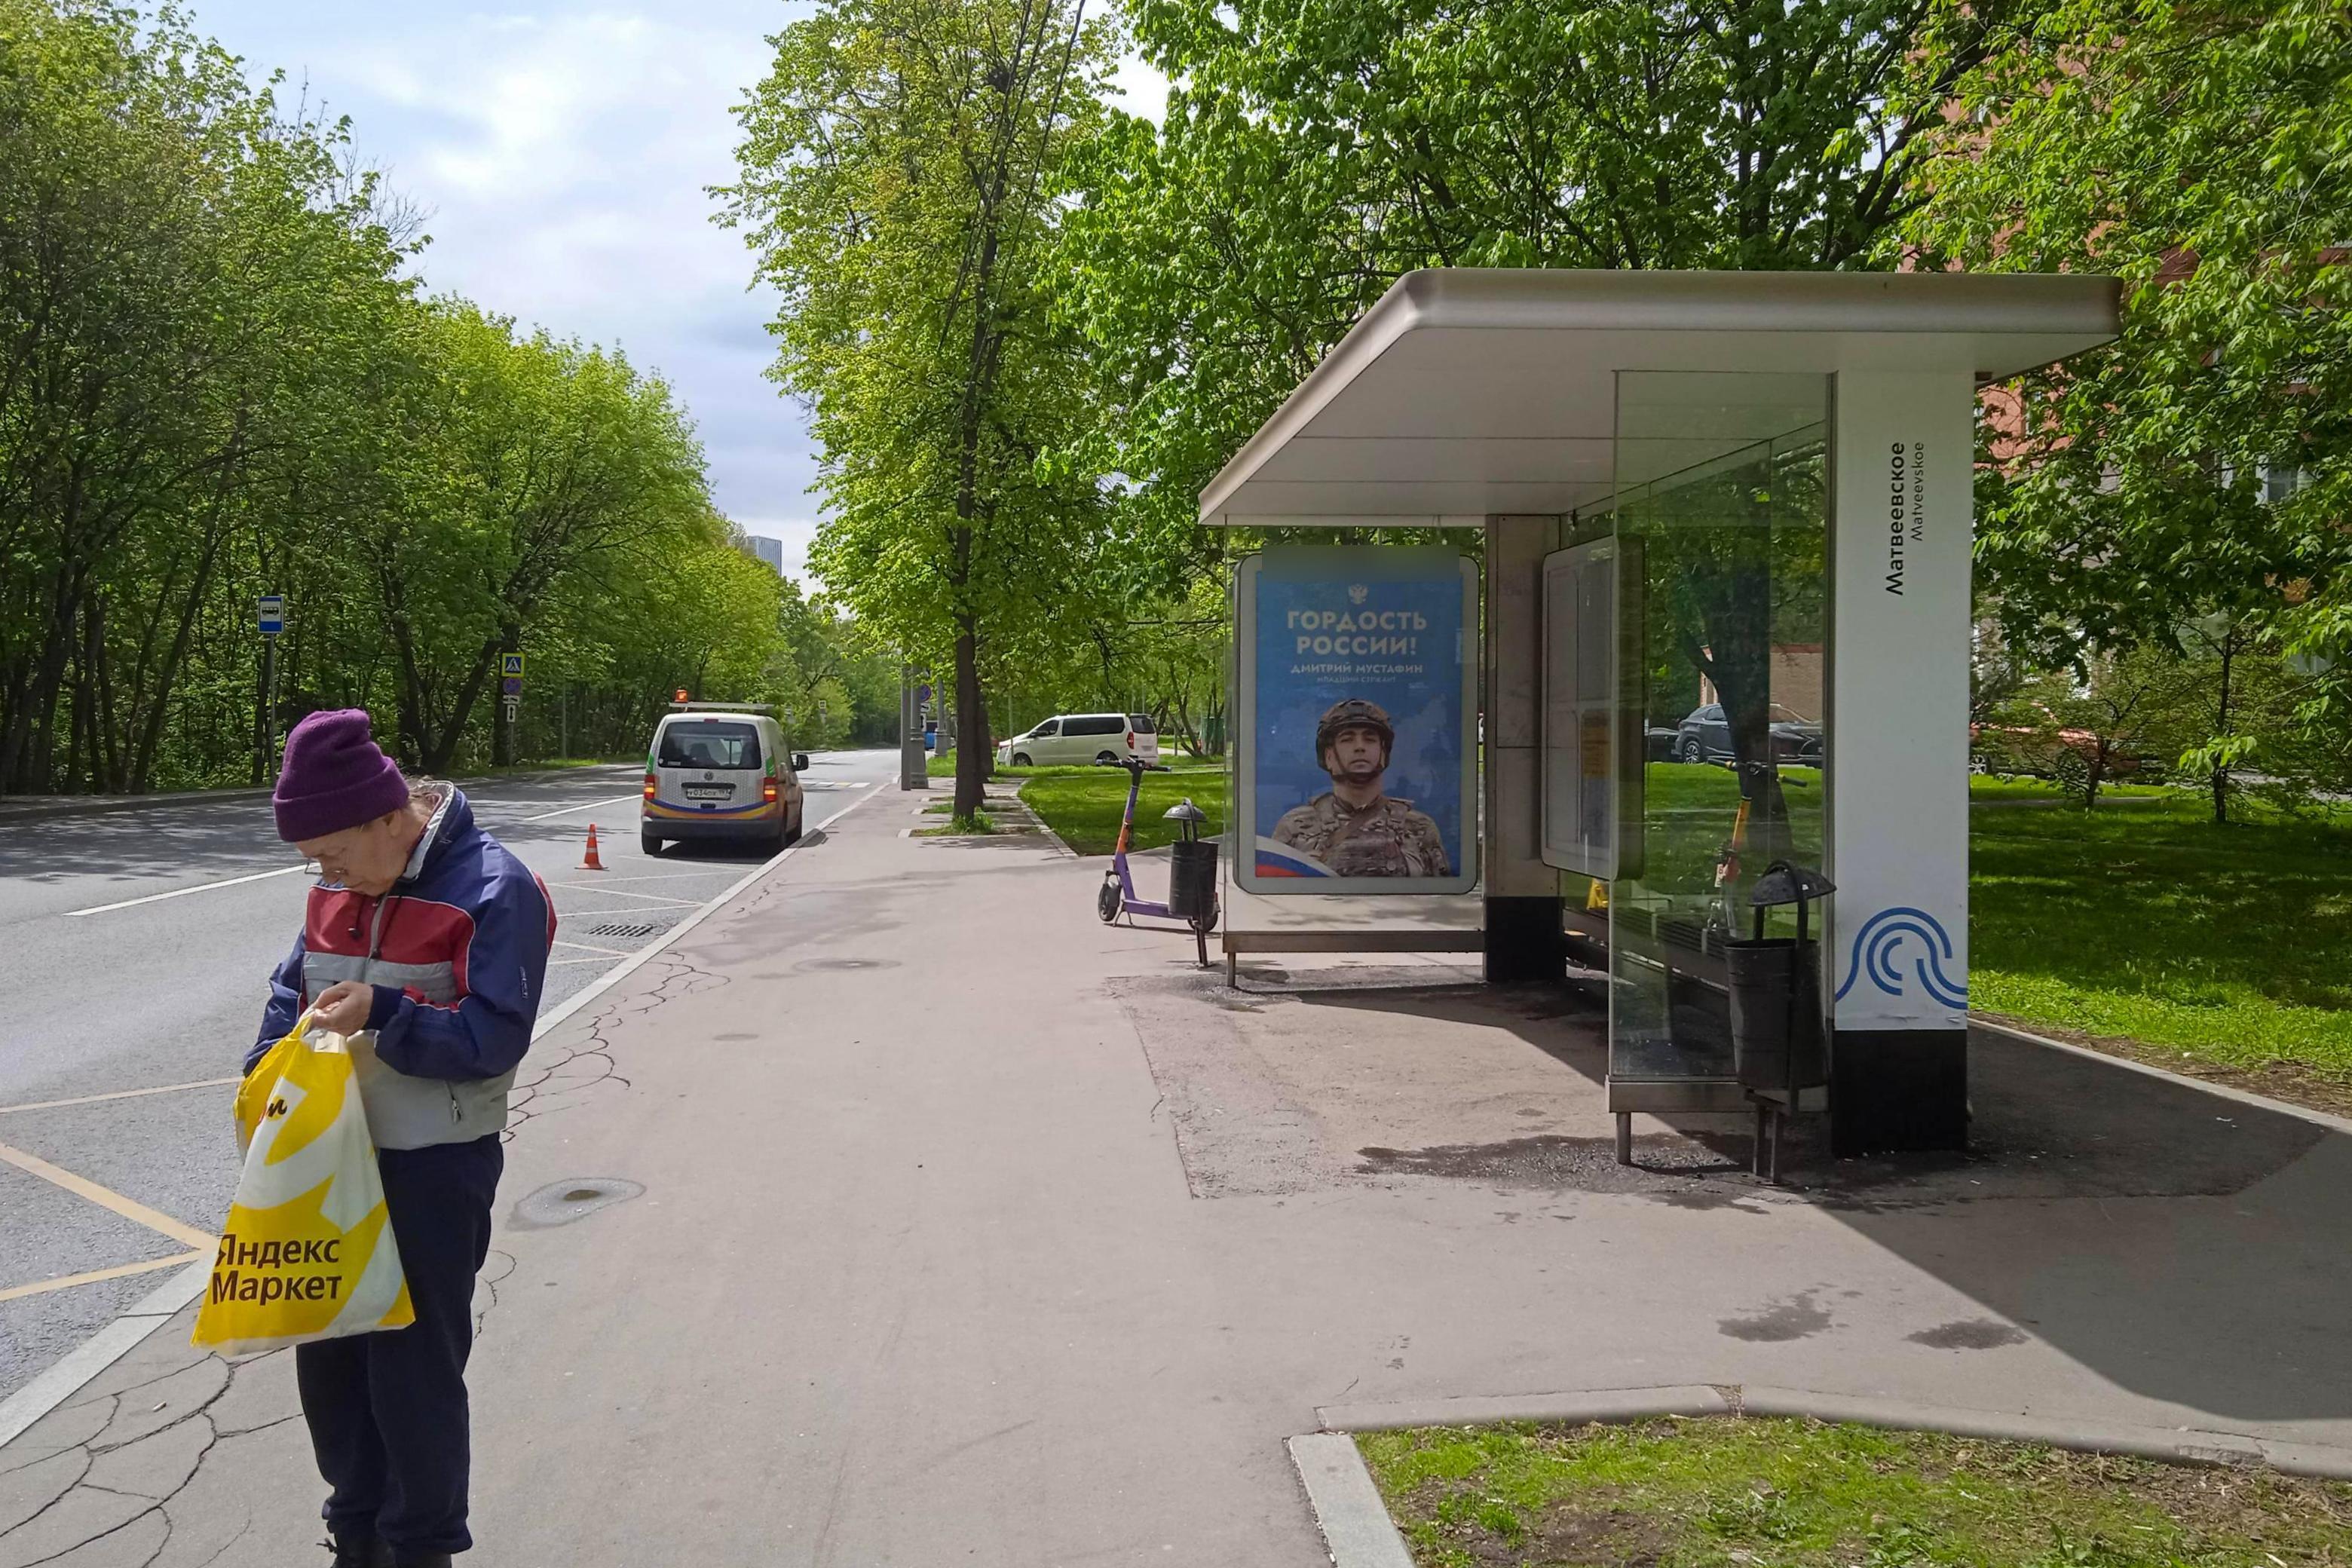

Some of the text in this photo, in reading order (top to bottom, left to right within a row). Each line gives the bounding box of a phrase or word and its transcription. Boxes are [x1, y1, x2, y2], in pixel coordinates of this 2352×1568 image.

[1909, 442, 1925, 541] Matveevskoe
[1885, 442, 1905, 596] Матвеевское
[1287, 610, 1428, 632] ГОРДОСТЬ
[1296, 635, 1417, 655] РОССИИ!
[1291, 661, 1423, 674] ДМИТРИЙ МУСТАФИН
[215, 1233, 341, 1269] Яндекс
[212, 1270, 342, 1305] Маркет
